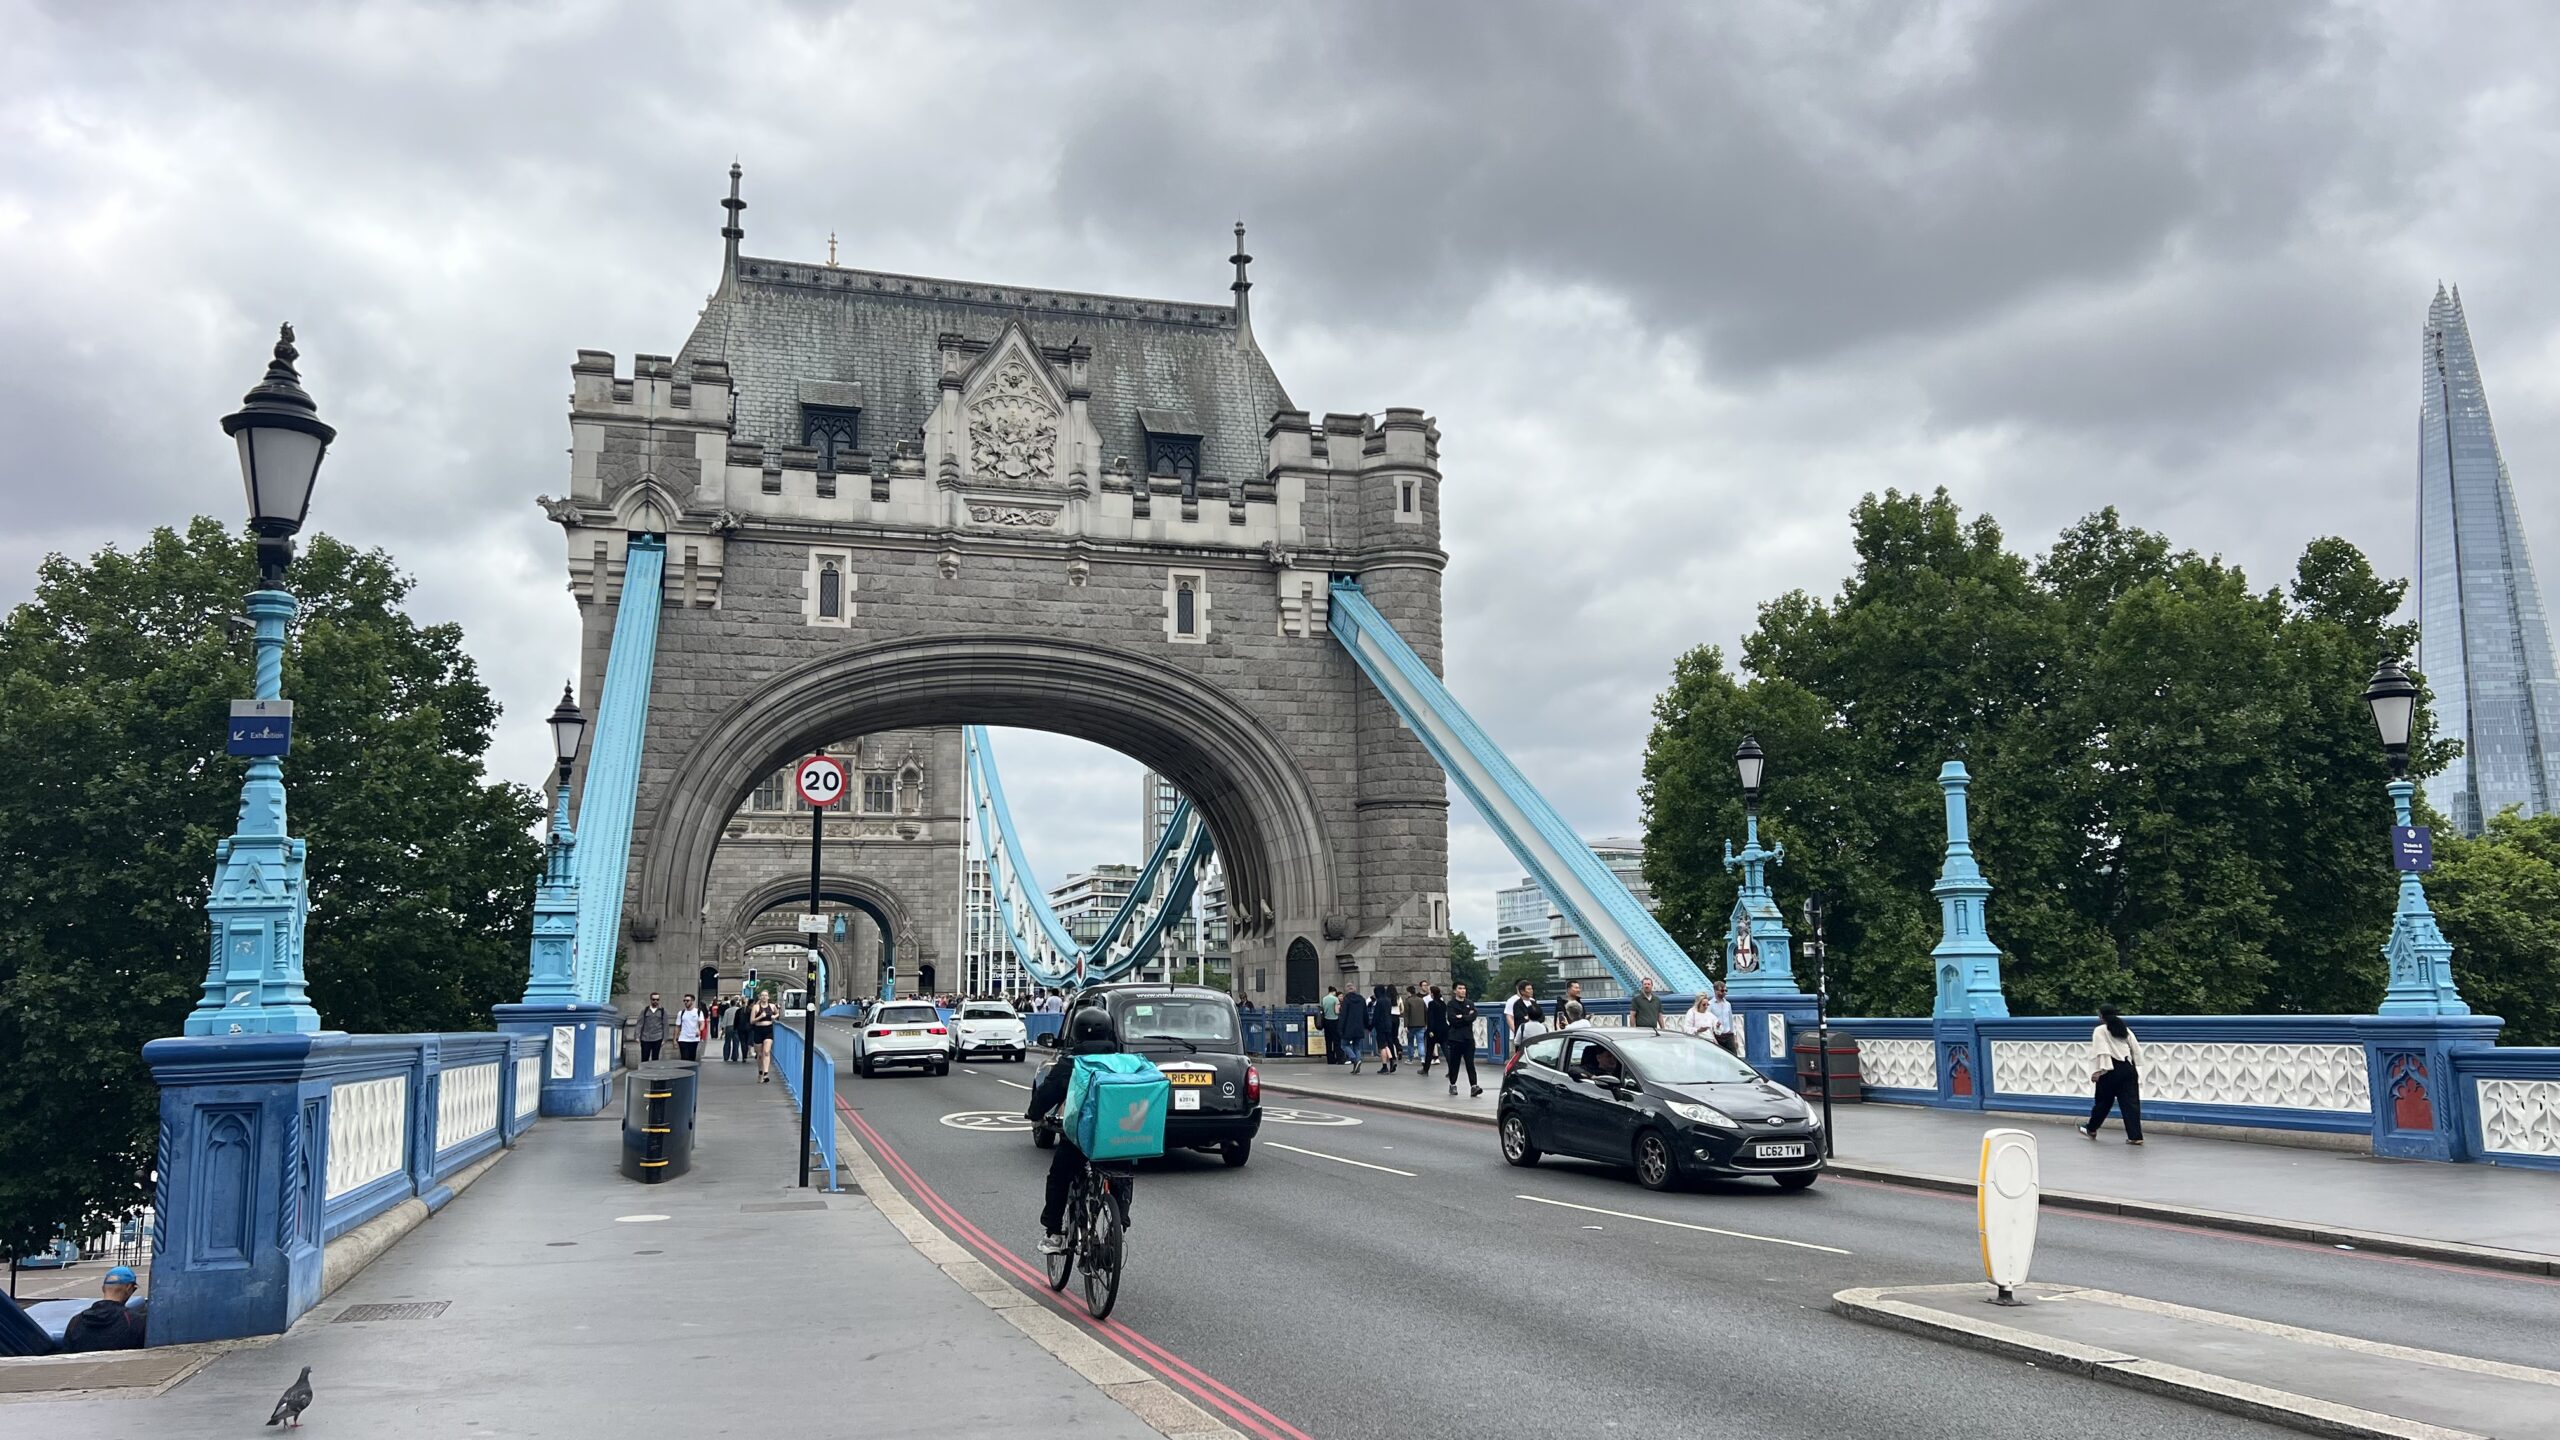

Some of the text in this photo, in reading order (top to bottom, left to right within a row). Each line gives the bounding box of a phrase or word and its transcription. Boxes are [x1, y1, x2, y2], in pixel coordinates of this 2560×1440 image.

[805, 771, 840, 791] 20
[1188, 1074, 1207, 1083] PXX
[1760, 1147, 1783, 1157] LC62
